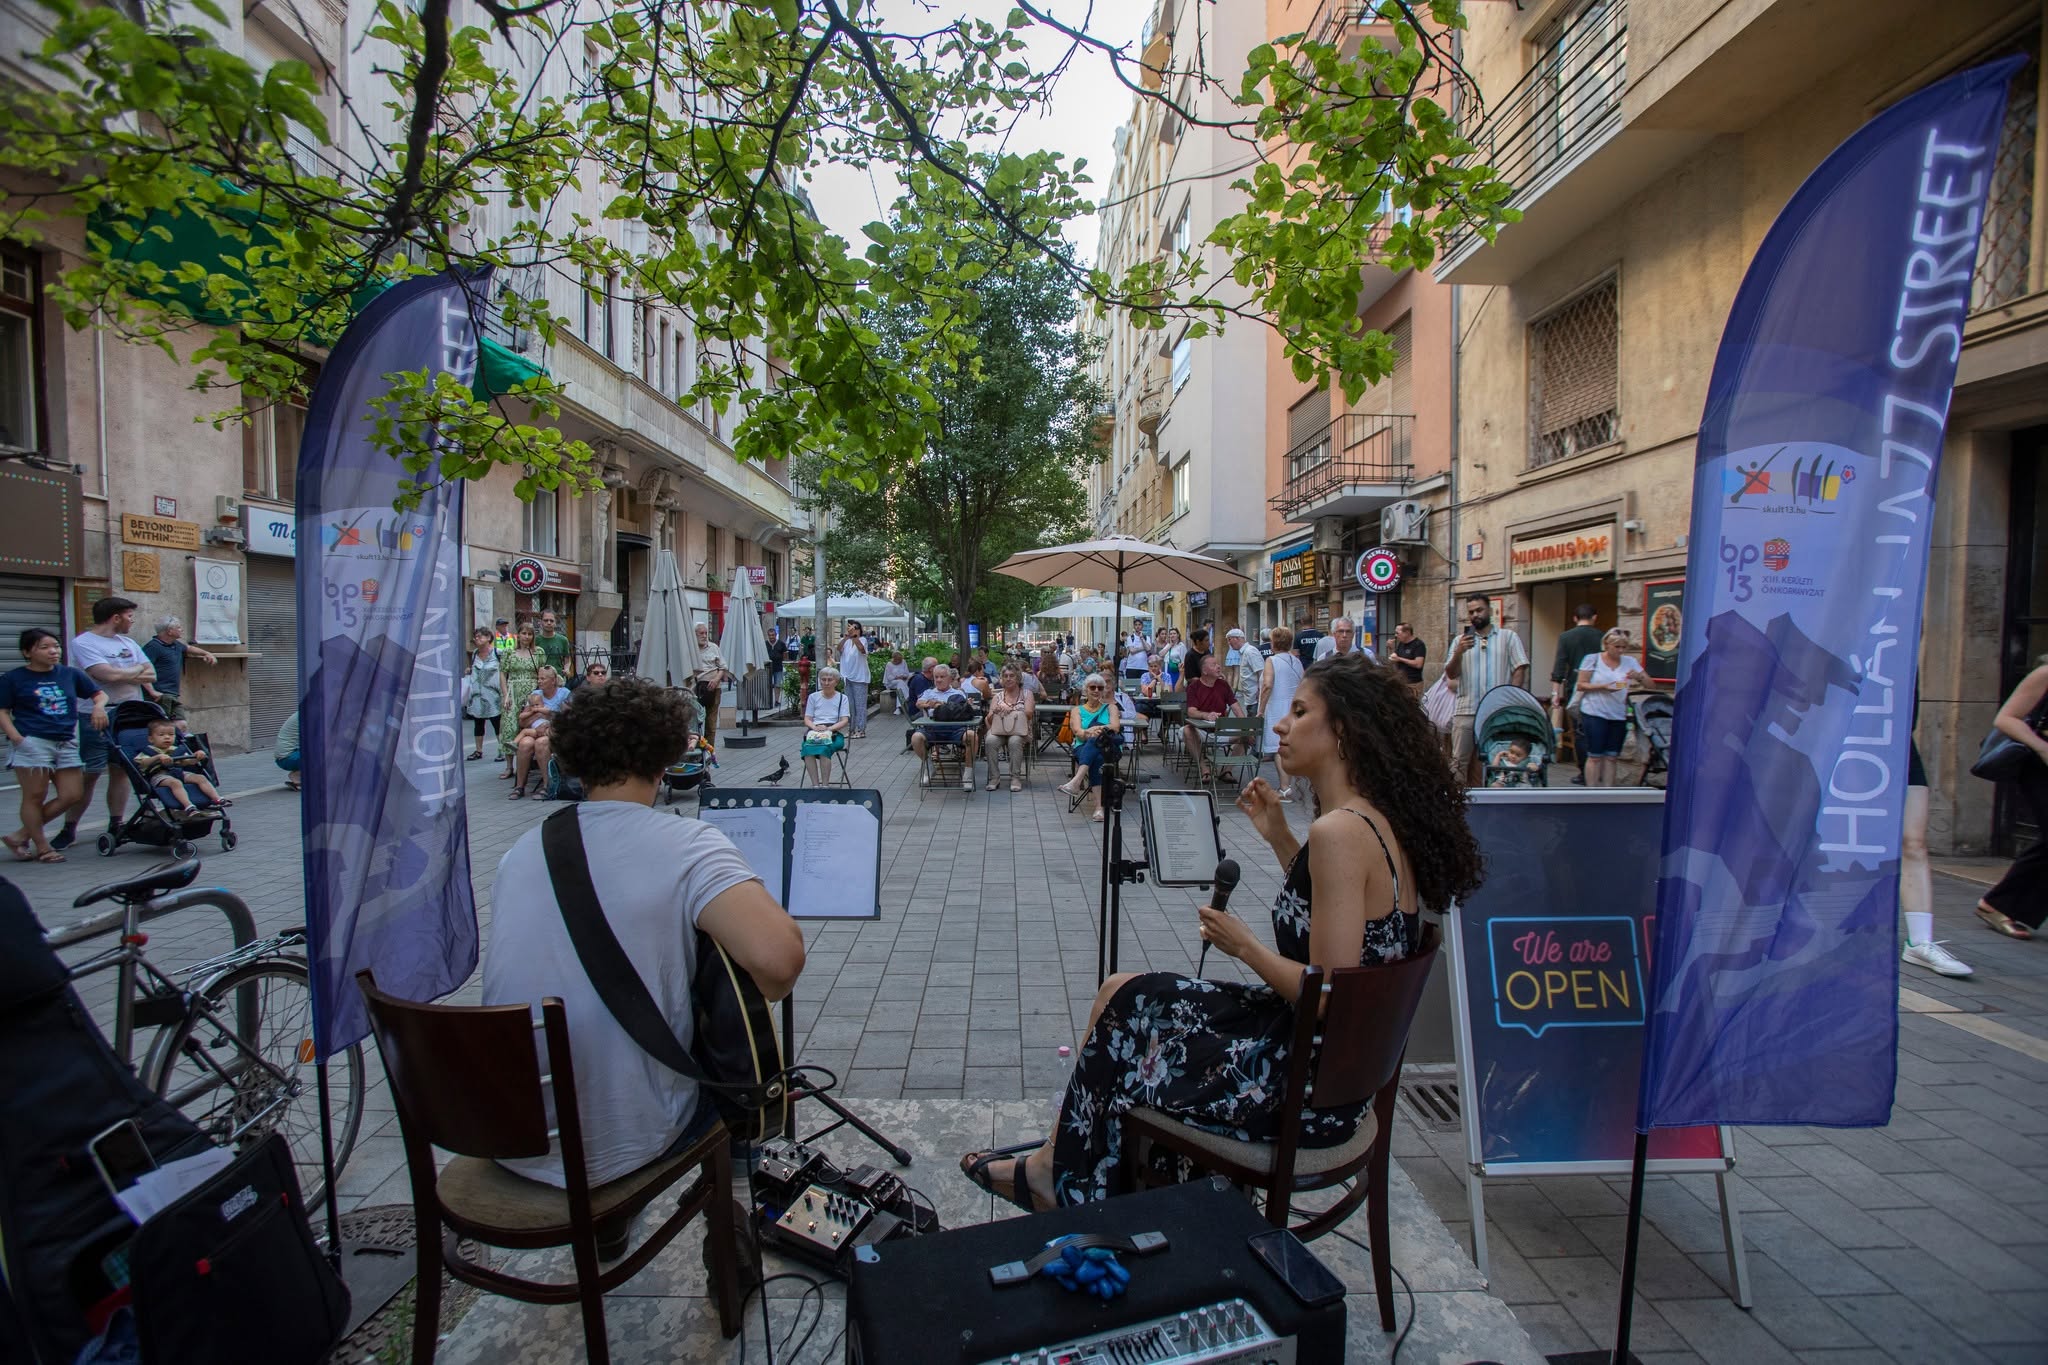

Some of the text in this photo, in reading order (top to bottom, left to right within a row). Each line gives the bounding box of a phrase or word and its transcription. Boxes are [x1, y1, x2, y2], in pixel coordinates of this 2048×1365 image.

[1889, 128, 1986, 369] STREET
[1762, 505, 1806, 515] skult13.hu
[130, 519, 174, 533] BEYOND
[131, 530, 170, 542] WITHIN
[1366, 549, 1397, 560] NEMZETI
[1720, 536, 1759, 571] bp
[1377, 565, 1387, 575] T
[1726, 565, 1753, 602] 13
[200, 591, 234, 602] Madal
[324, 577, 359, 604] bp
[331, 600, 358, 629] 13
[1513, 931, 1612, 964] We are
[1506, 970, 1630, 1010] OPEN
